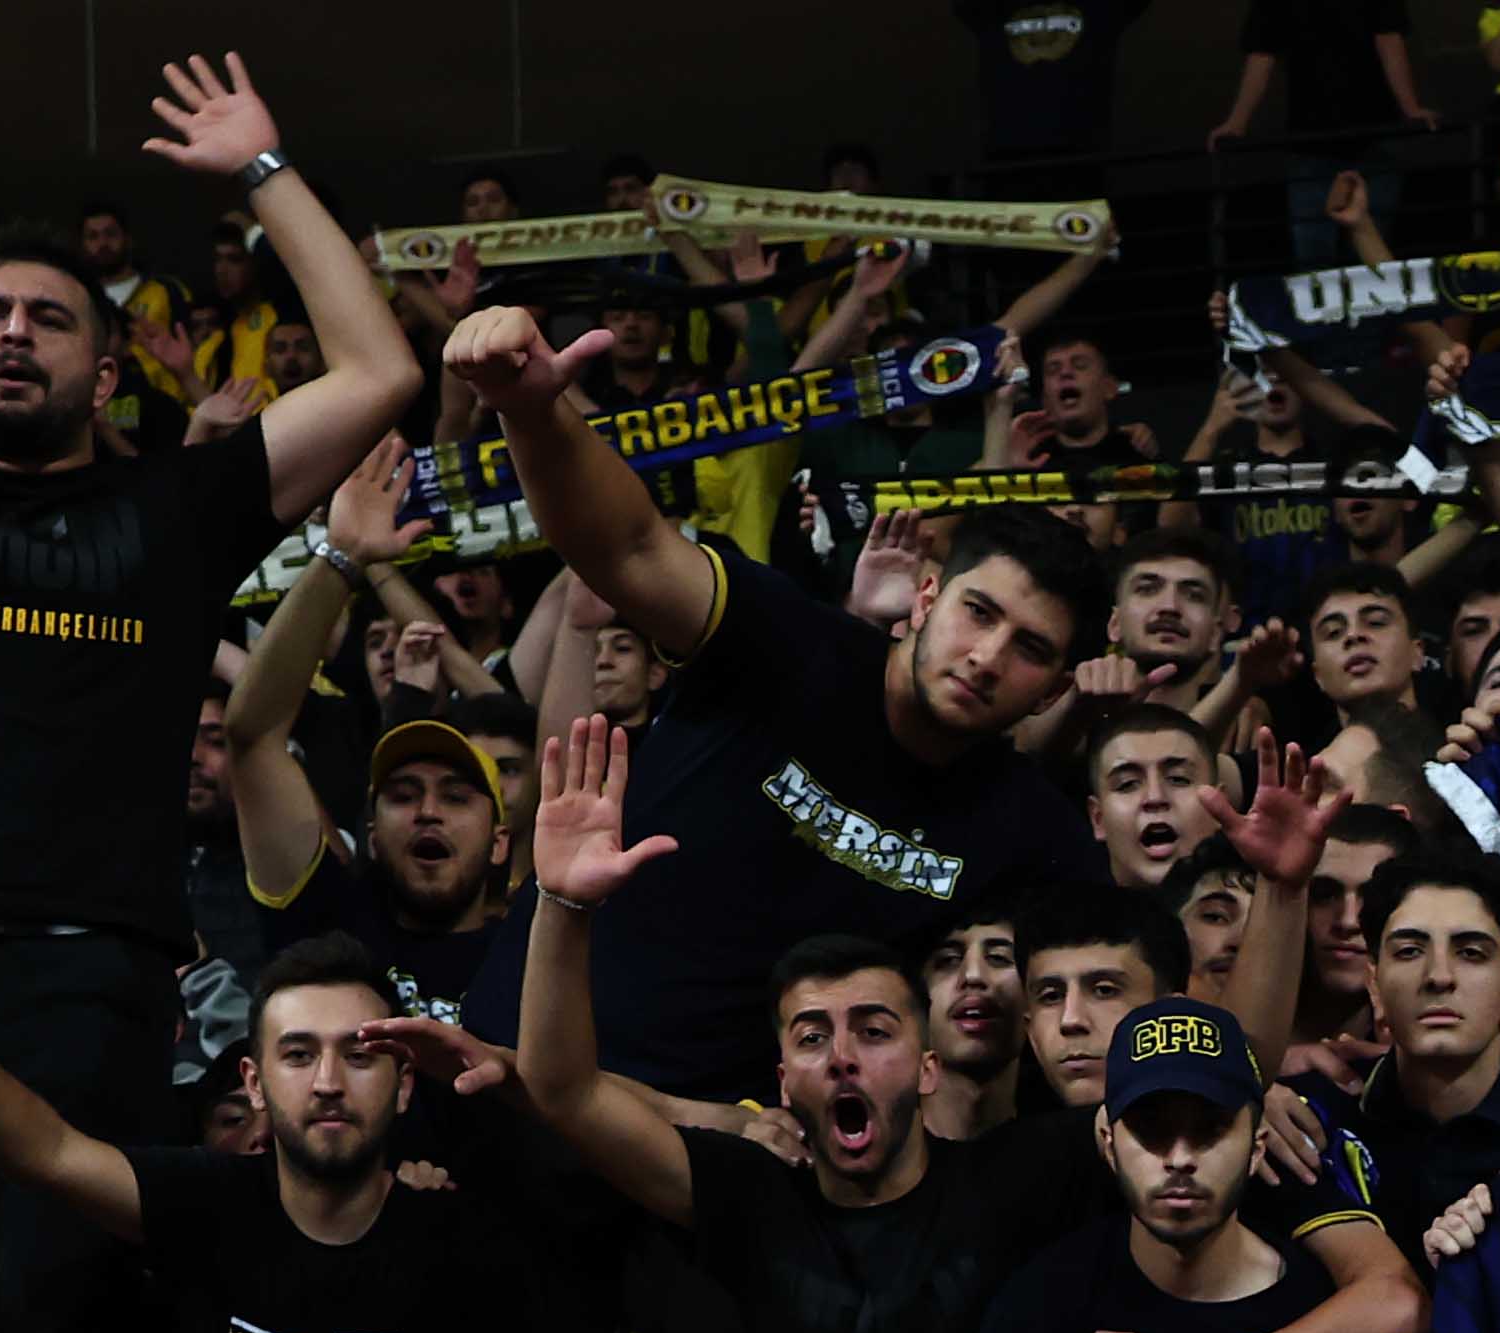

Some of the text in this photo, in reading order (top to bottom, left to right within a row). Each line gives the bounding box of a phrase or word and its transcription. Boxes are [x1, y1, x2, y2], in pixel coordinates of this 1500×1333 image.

[1285, 257, 1438, 322] UNI
[479, 367, 841, 487] FRBAHÇE
[1130, 1015, 1223, 1063] GFB
